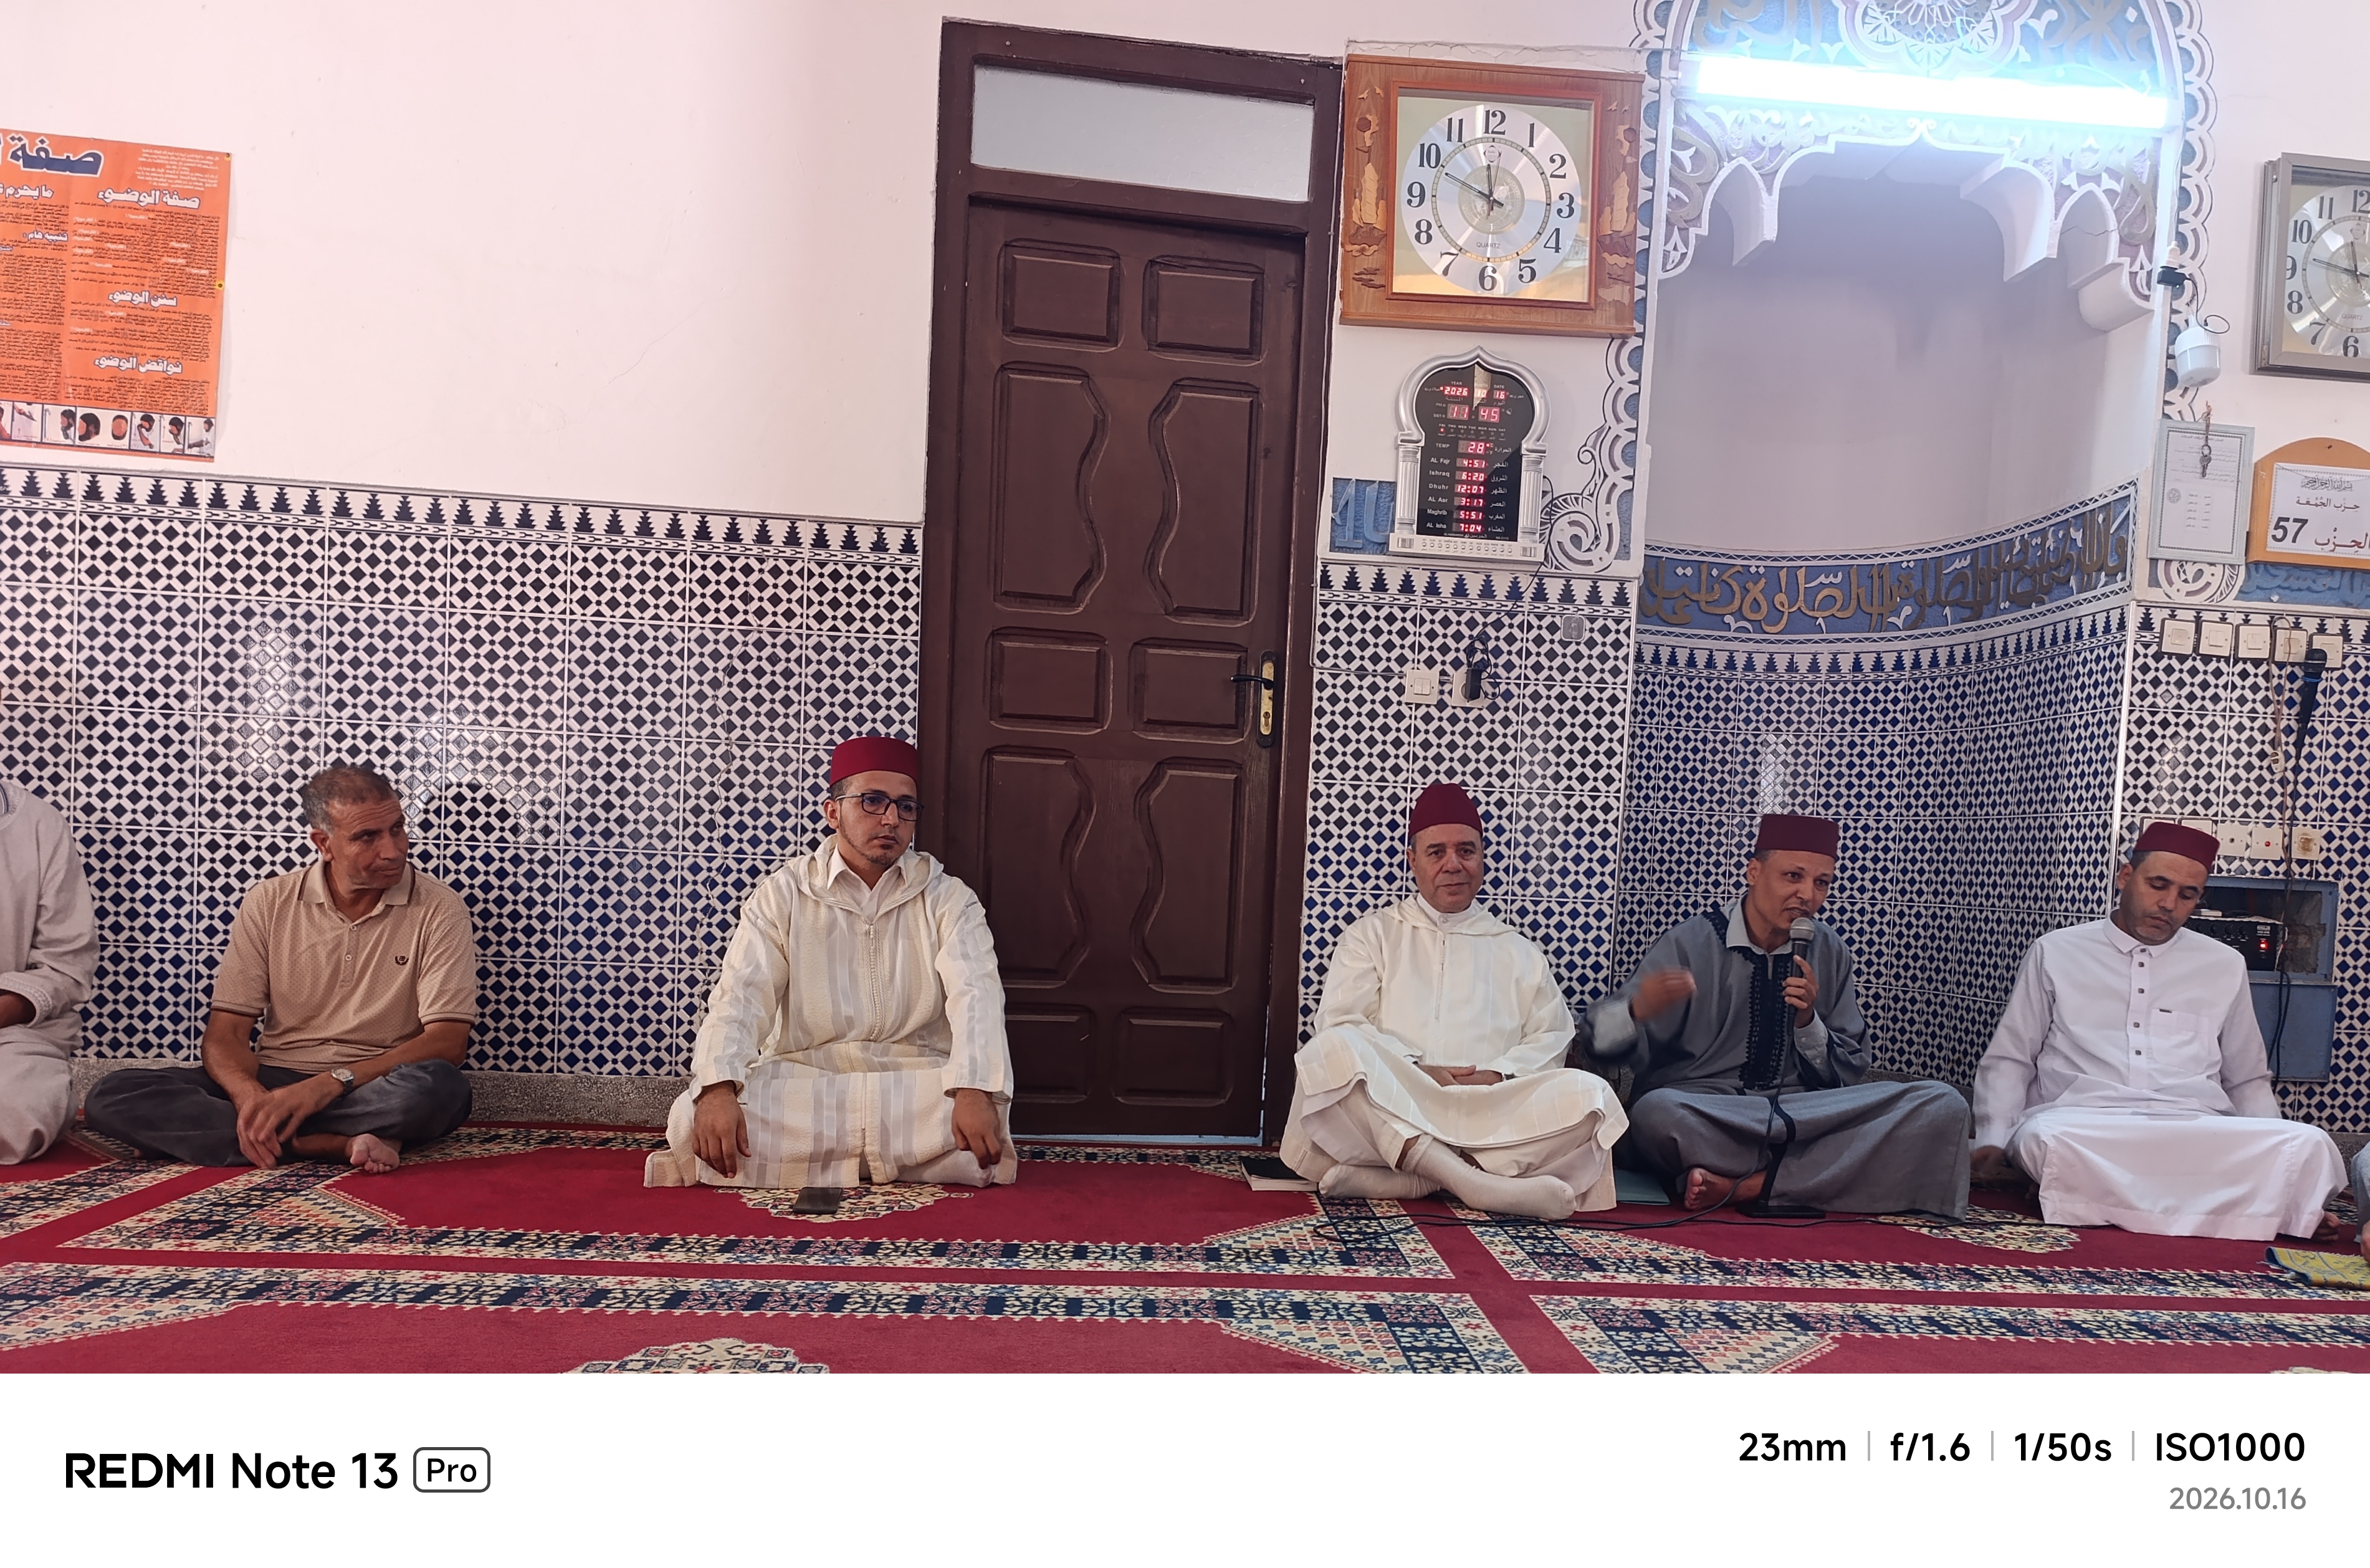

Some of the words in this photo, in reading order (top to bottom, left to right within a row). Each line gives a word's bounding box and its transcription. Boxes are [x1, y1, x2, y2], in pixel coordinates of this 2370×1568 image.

[1446, 117, 1463, 143] 11
[1484, 110, 1506, 135] 12
[1529, 123, 1535, 147] 1
[7, 133, 104, 178] صفة
[1418, 143, 1441, 169] 10
[1549, 154, 1567, 179] 2
[5, 184, 40, 200] يحرم
[41, 184, 54, 199] ما
[97, 187, 160, 208] الوضوء
[162, 189, 201, 209] صفة
[1407, 181, 1426, 208] 9
[2351, 189, 2370, 213] 12
[1556, 193, 1574, 219] 3
[2318, 196, 2334, 219] 11
[1415, 219, 1433, 244] 8
[1544, 227, 1561, 254] 4
[2291, 219, 2313, 244] 10
[1476, 241, 1501, 249] QUARTZ
[1440, 251, 1459, 277] 7
[1518, 259, 1537, 283] 5
[1479, 265, 1497, 291] 6
[108, 289, 150, 304] الوضوء
[150, 293, 177, 307] سنن
[2286, 290, 2303, 314] 8
[2309, 321, 2326, 345] 7
[2343, 335, 2359, 358] 6
[94, 355, 137, 371] الوضوء
[138, 358, 182, 375] نواقض
[1445, 386, 1468, 396] 2026
[1481, 409, 1499, 421] 45
[1468, 442, 1484, 454] 28
[1463, 459, 1485, 467] 4:51
[1461, 472, 1484, 480] 6:20
[1457, 485, 1484, 493] 12:07
[1460, 497, 1483, 506] 3:17
[1460, 510, 1482, 519] 5:51
[1460, 523, 1481, 532] 7:04
[2272, 517, 2308, 543] 57
